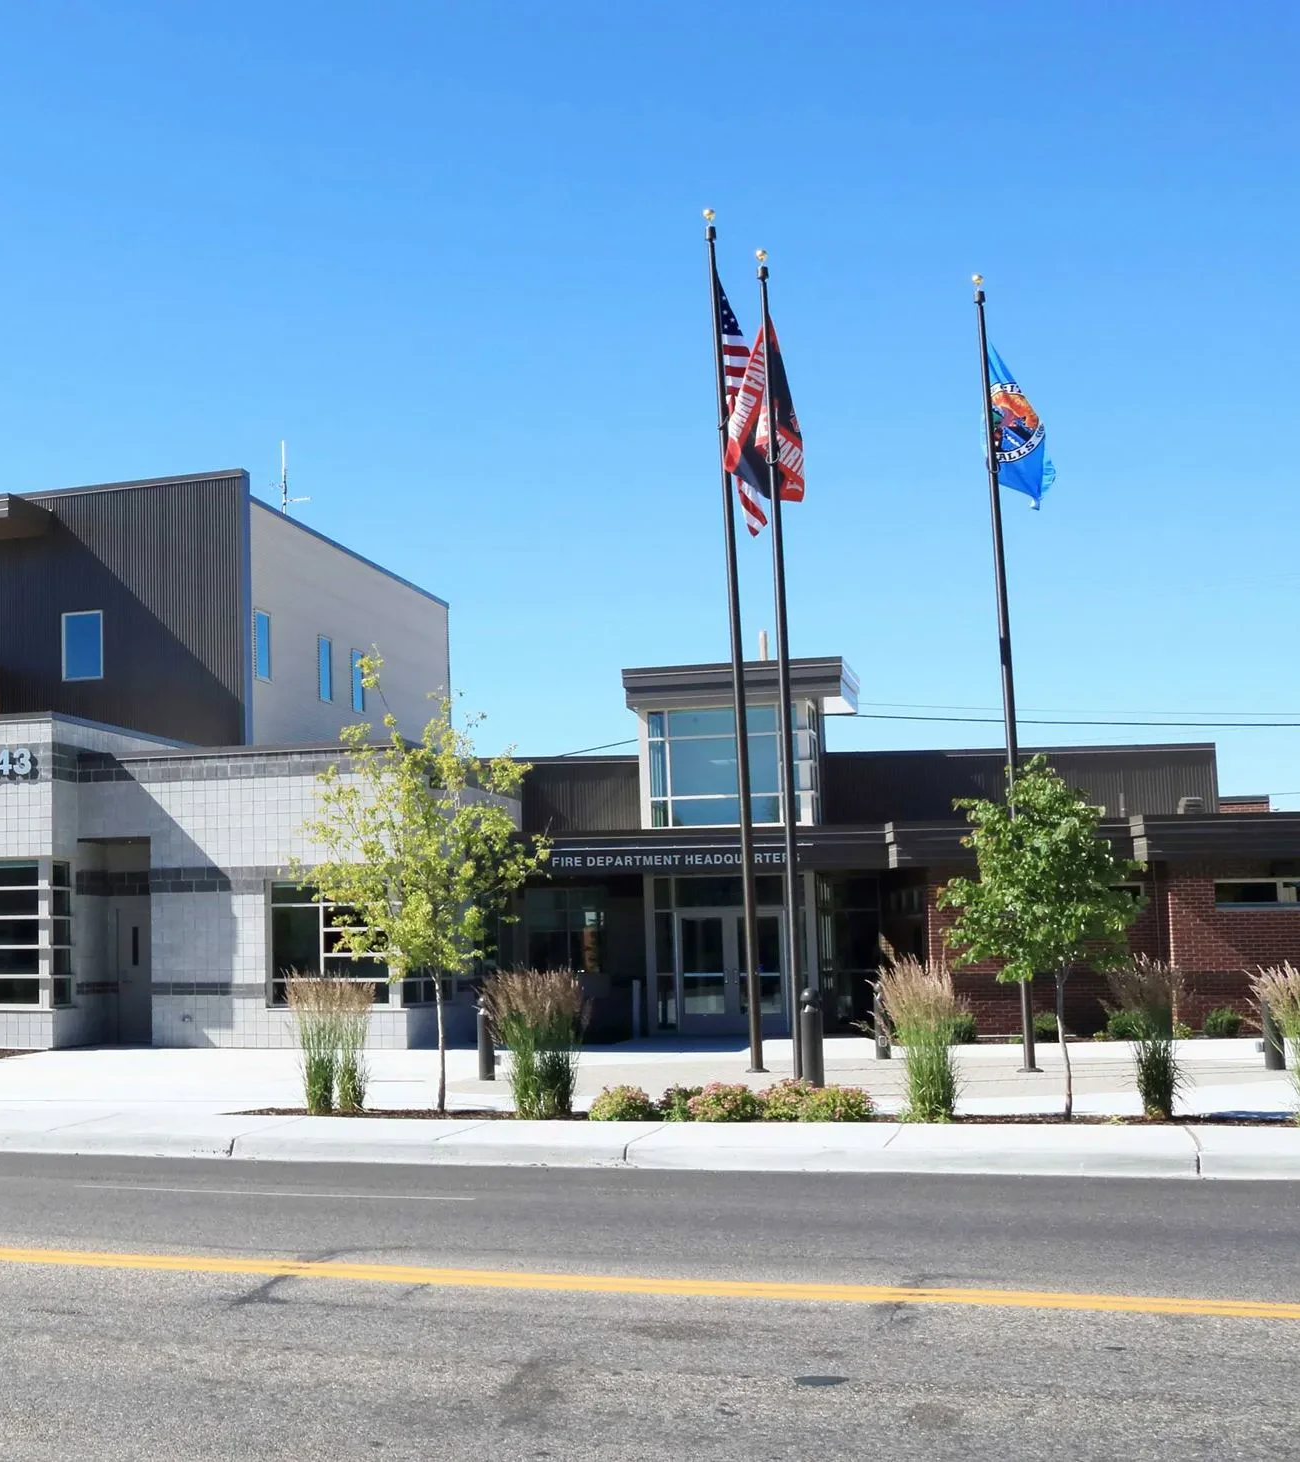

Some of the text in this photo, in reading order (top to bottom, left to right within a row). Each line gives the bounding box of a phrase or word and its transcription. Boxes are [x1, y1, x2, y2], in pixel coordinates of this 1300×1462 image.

[995, 441, 1035, 461] ALLS
[552, 852, 800, 867] FIRE DEPARTMENT HEADQURTER
